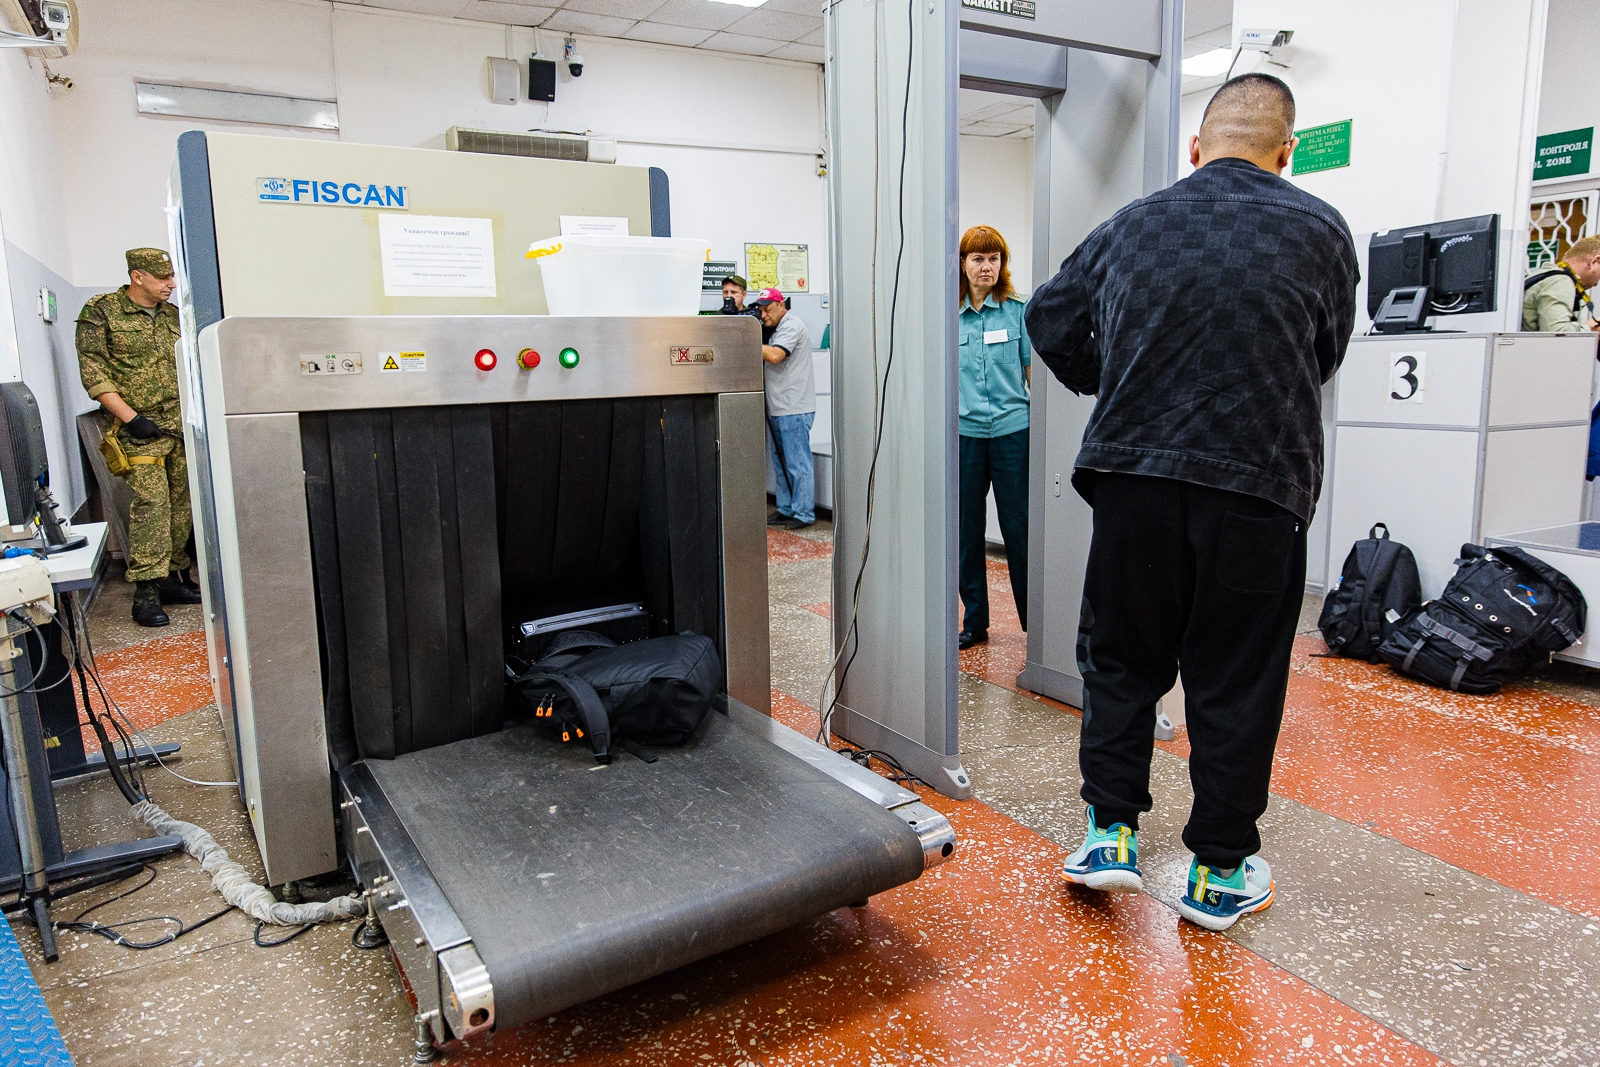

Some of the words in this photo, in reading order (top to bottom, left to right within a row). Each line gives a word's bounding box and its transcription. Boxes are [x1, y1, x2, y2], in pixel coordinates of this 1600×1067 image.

[1300, 124, 1345, 139] ВНИМАНИЕ!
[1539, 141, 1589, 157] КОНТРОЛЯ
[1546, 156, 1572, 167] ZONE
[292, 179, 405, 207] FISCAN
[403, 227, 439, 235] Уважаемые
[1391, 355, 1419, 400] 3
